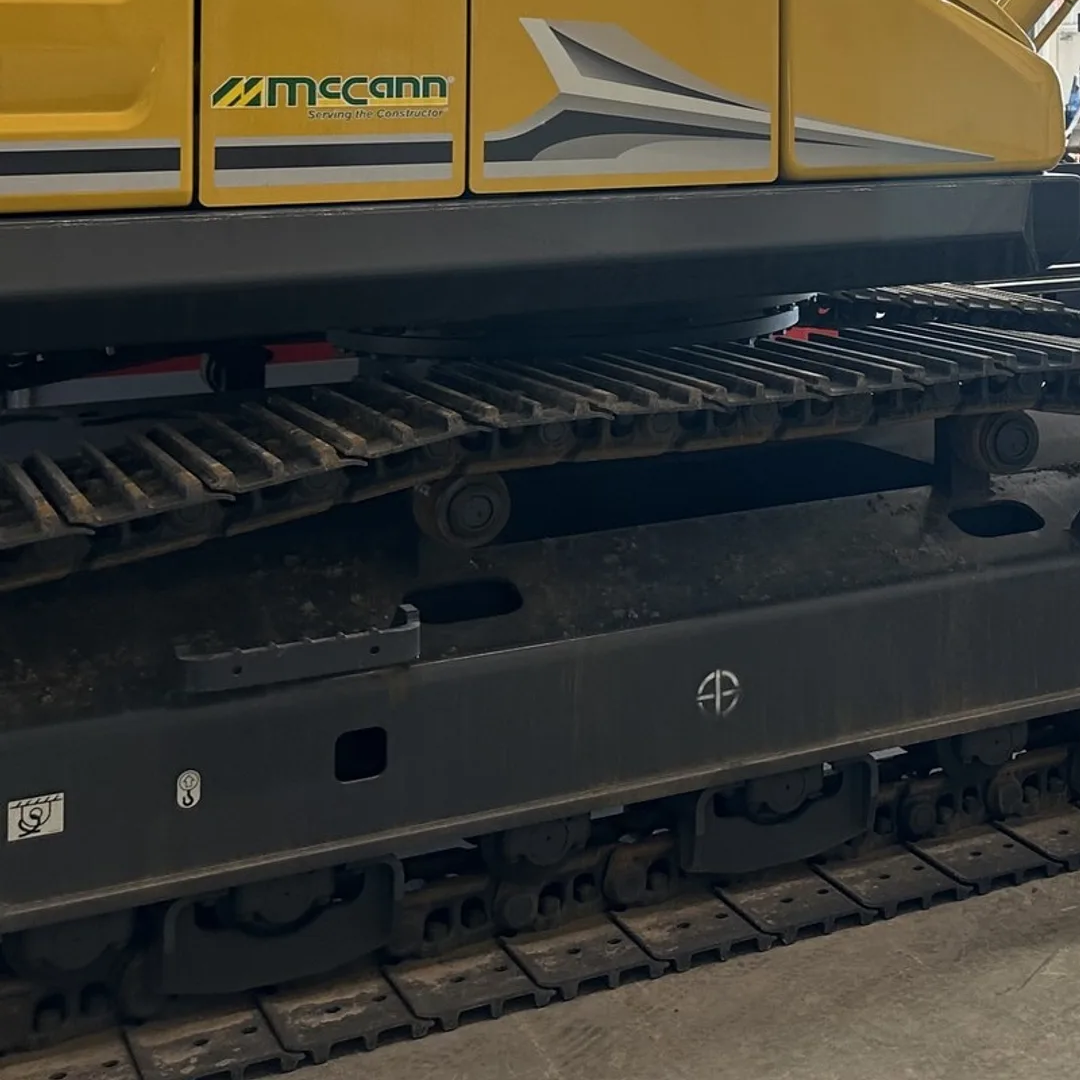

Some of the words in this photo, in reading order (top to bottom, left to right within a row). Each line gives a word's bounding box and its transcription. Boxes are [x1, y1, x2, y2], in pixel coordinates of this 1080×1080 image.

[308, 109, 352, 120] Serving
[355, 108, 373, 119] the
[376, 108, 443, 119] Constructor
